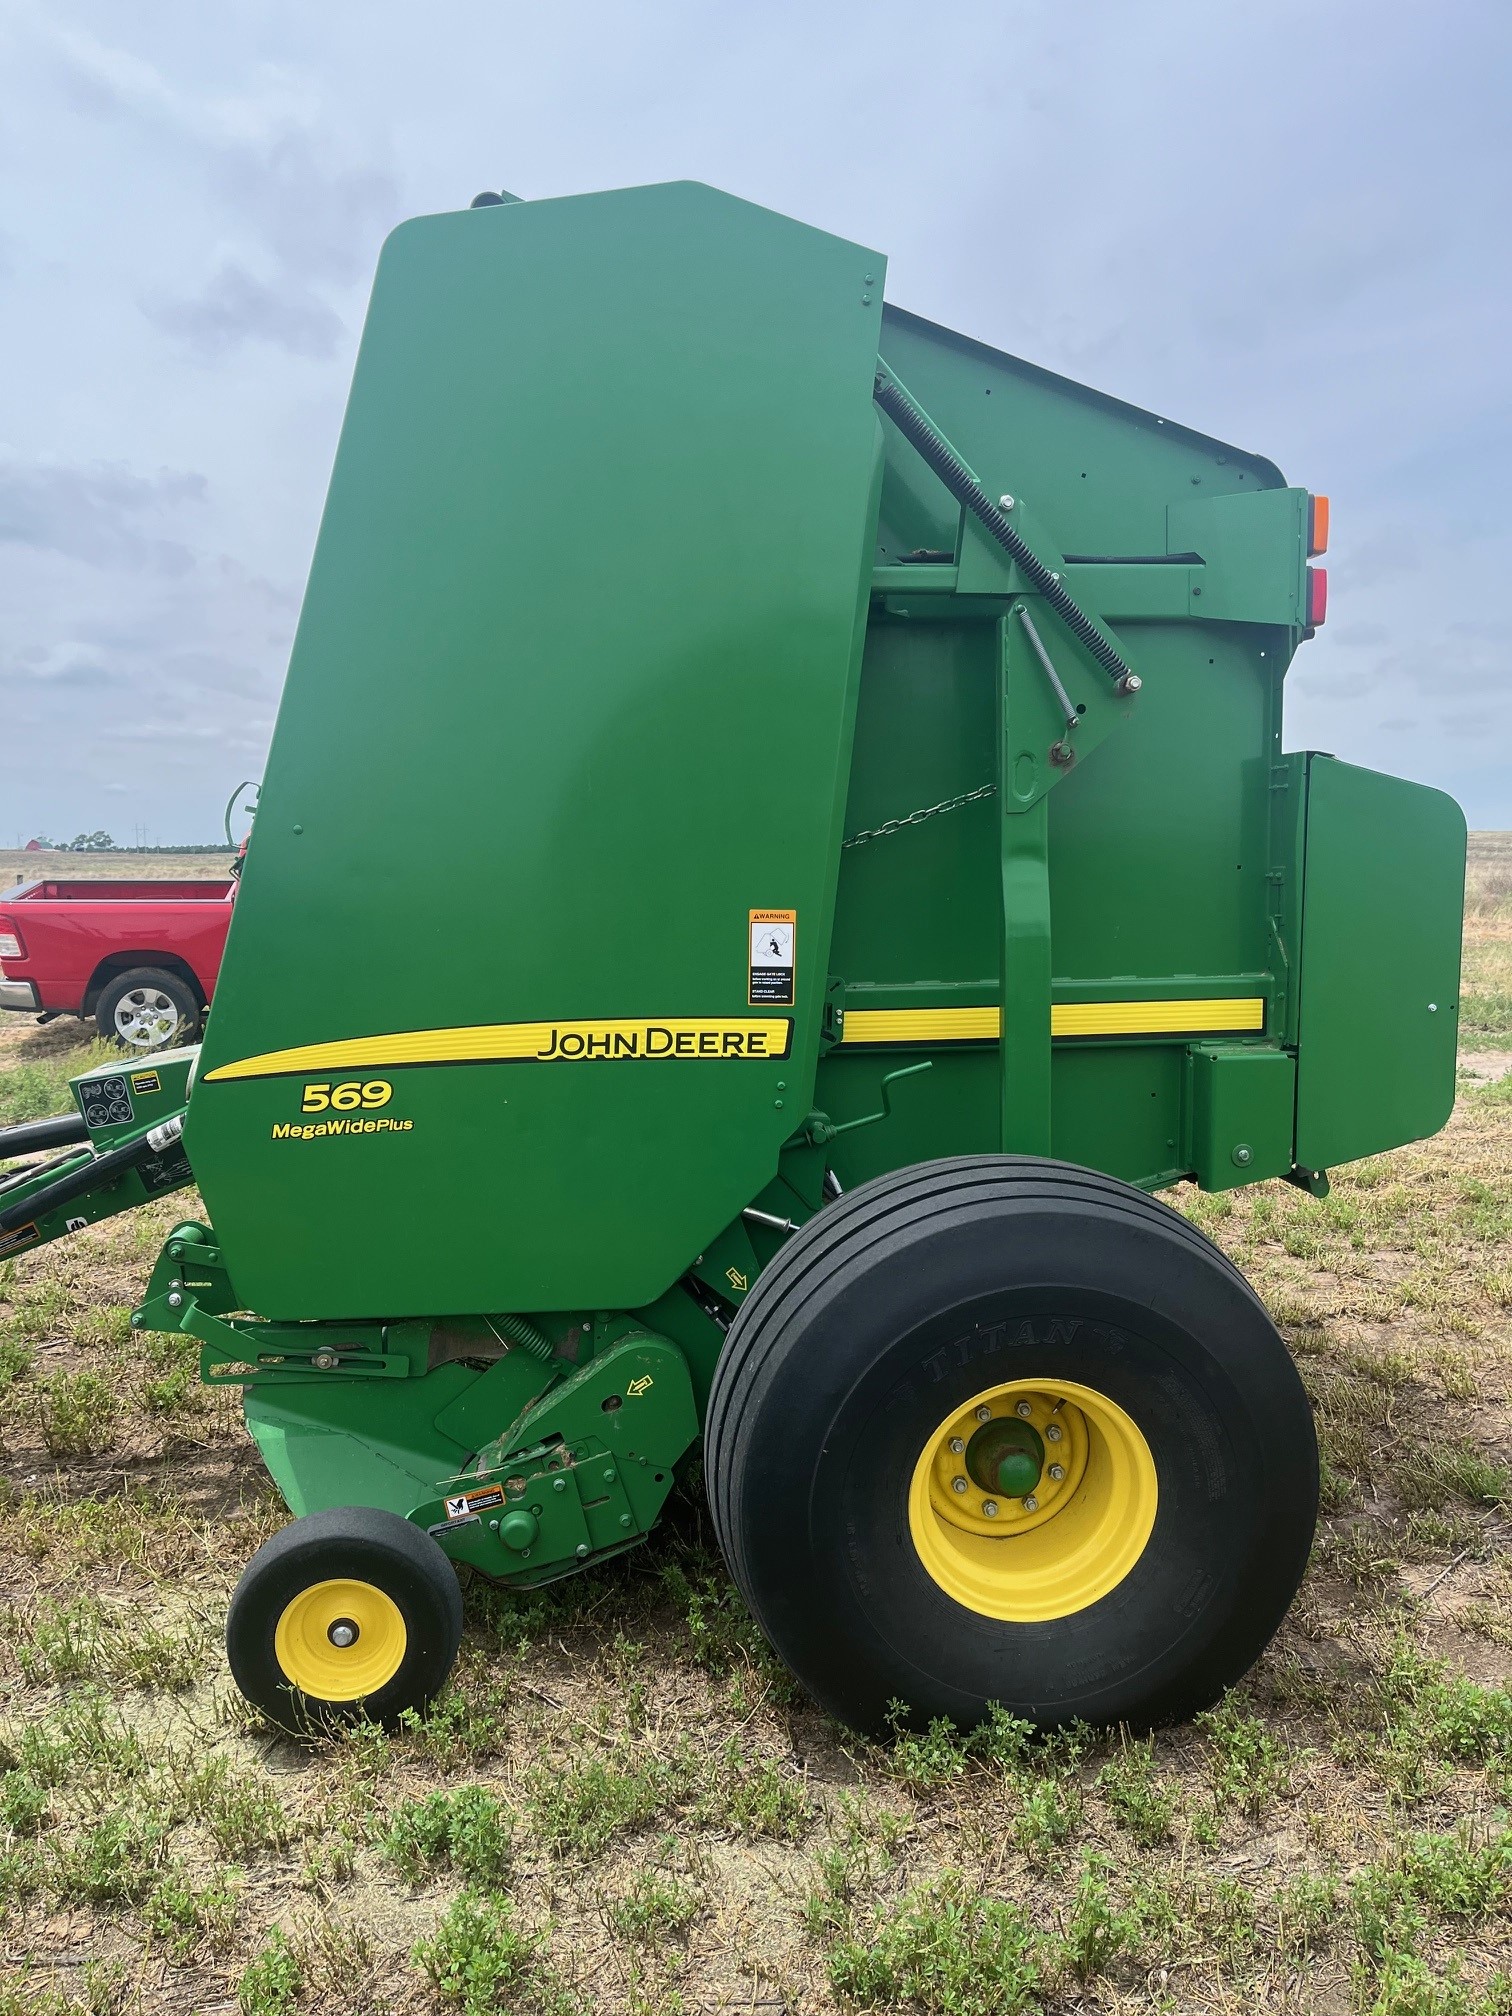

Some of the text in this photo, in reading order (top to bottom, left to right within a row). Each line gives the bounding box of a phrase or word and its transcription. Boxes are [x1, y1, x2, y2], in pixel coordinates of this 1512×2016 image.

[539, 1026, 769, 1058] JOHN DEERE
[301, 1081, 393, 1113] 569
[271, 1117, 414, 1140] MegaWidePlus
[921, 1320, 1084, 1383] TITAN
